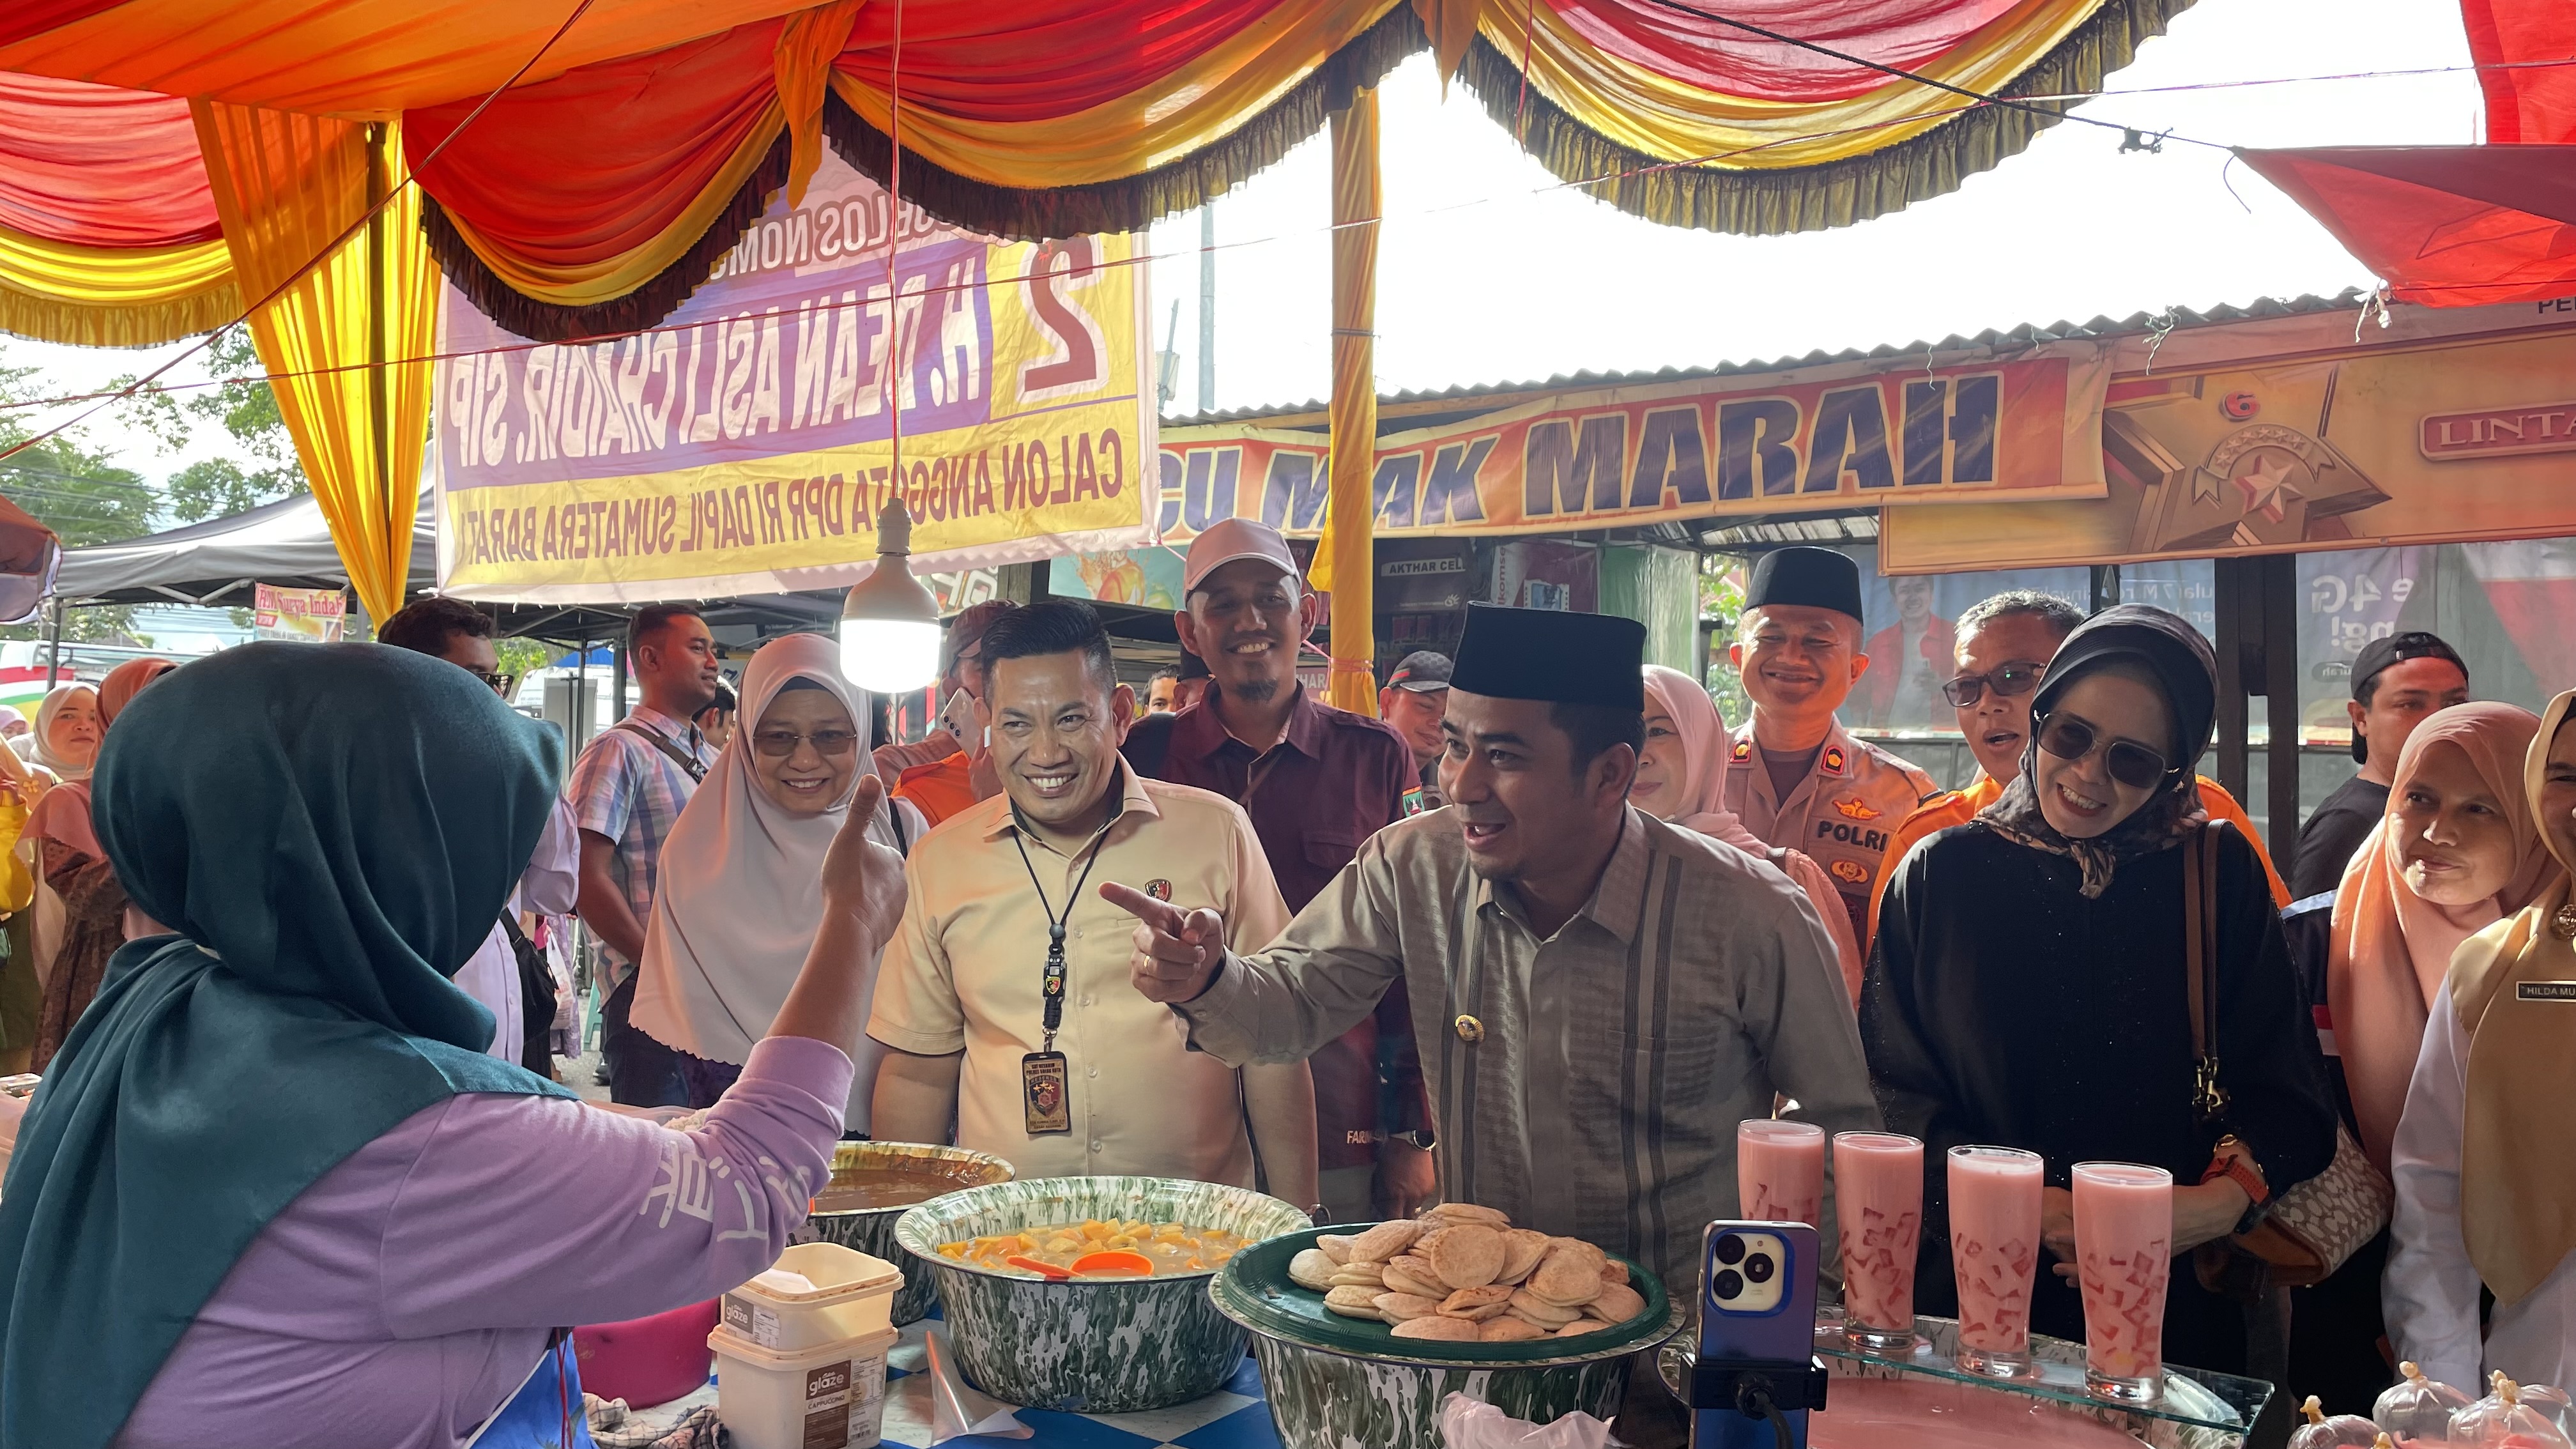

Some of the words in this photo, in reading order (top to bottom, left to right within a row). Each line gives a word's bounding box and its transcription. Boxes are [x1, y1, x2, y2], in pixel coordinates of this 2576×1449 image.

[1261, 436, 1495, 529] MAK
[1526, 376, 2000, 516] MARAH
[1390, 562, 1436, 574] AKTHAR
[277, 592, 307, 621] Surya
[1818, 820, 1887, 852] POLRI
[2527, 987, 2557, 995] HILDA
[726, 1305, 748, 1324] glaze
[809, 1374, 844, 1396] glaze
[808, 1395, 845, 1409] CAPPUCCINO
